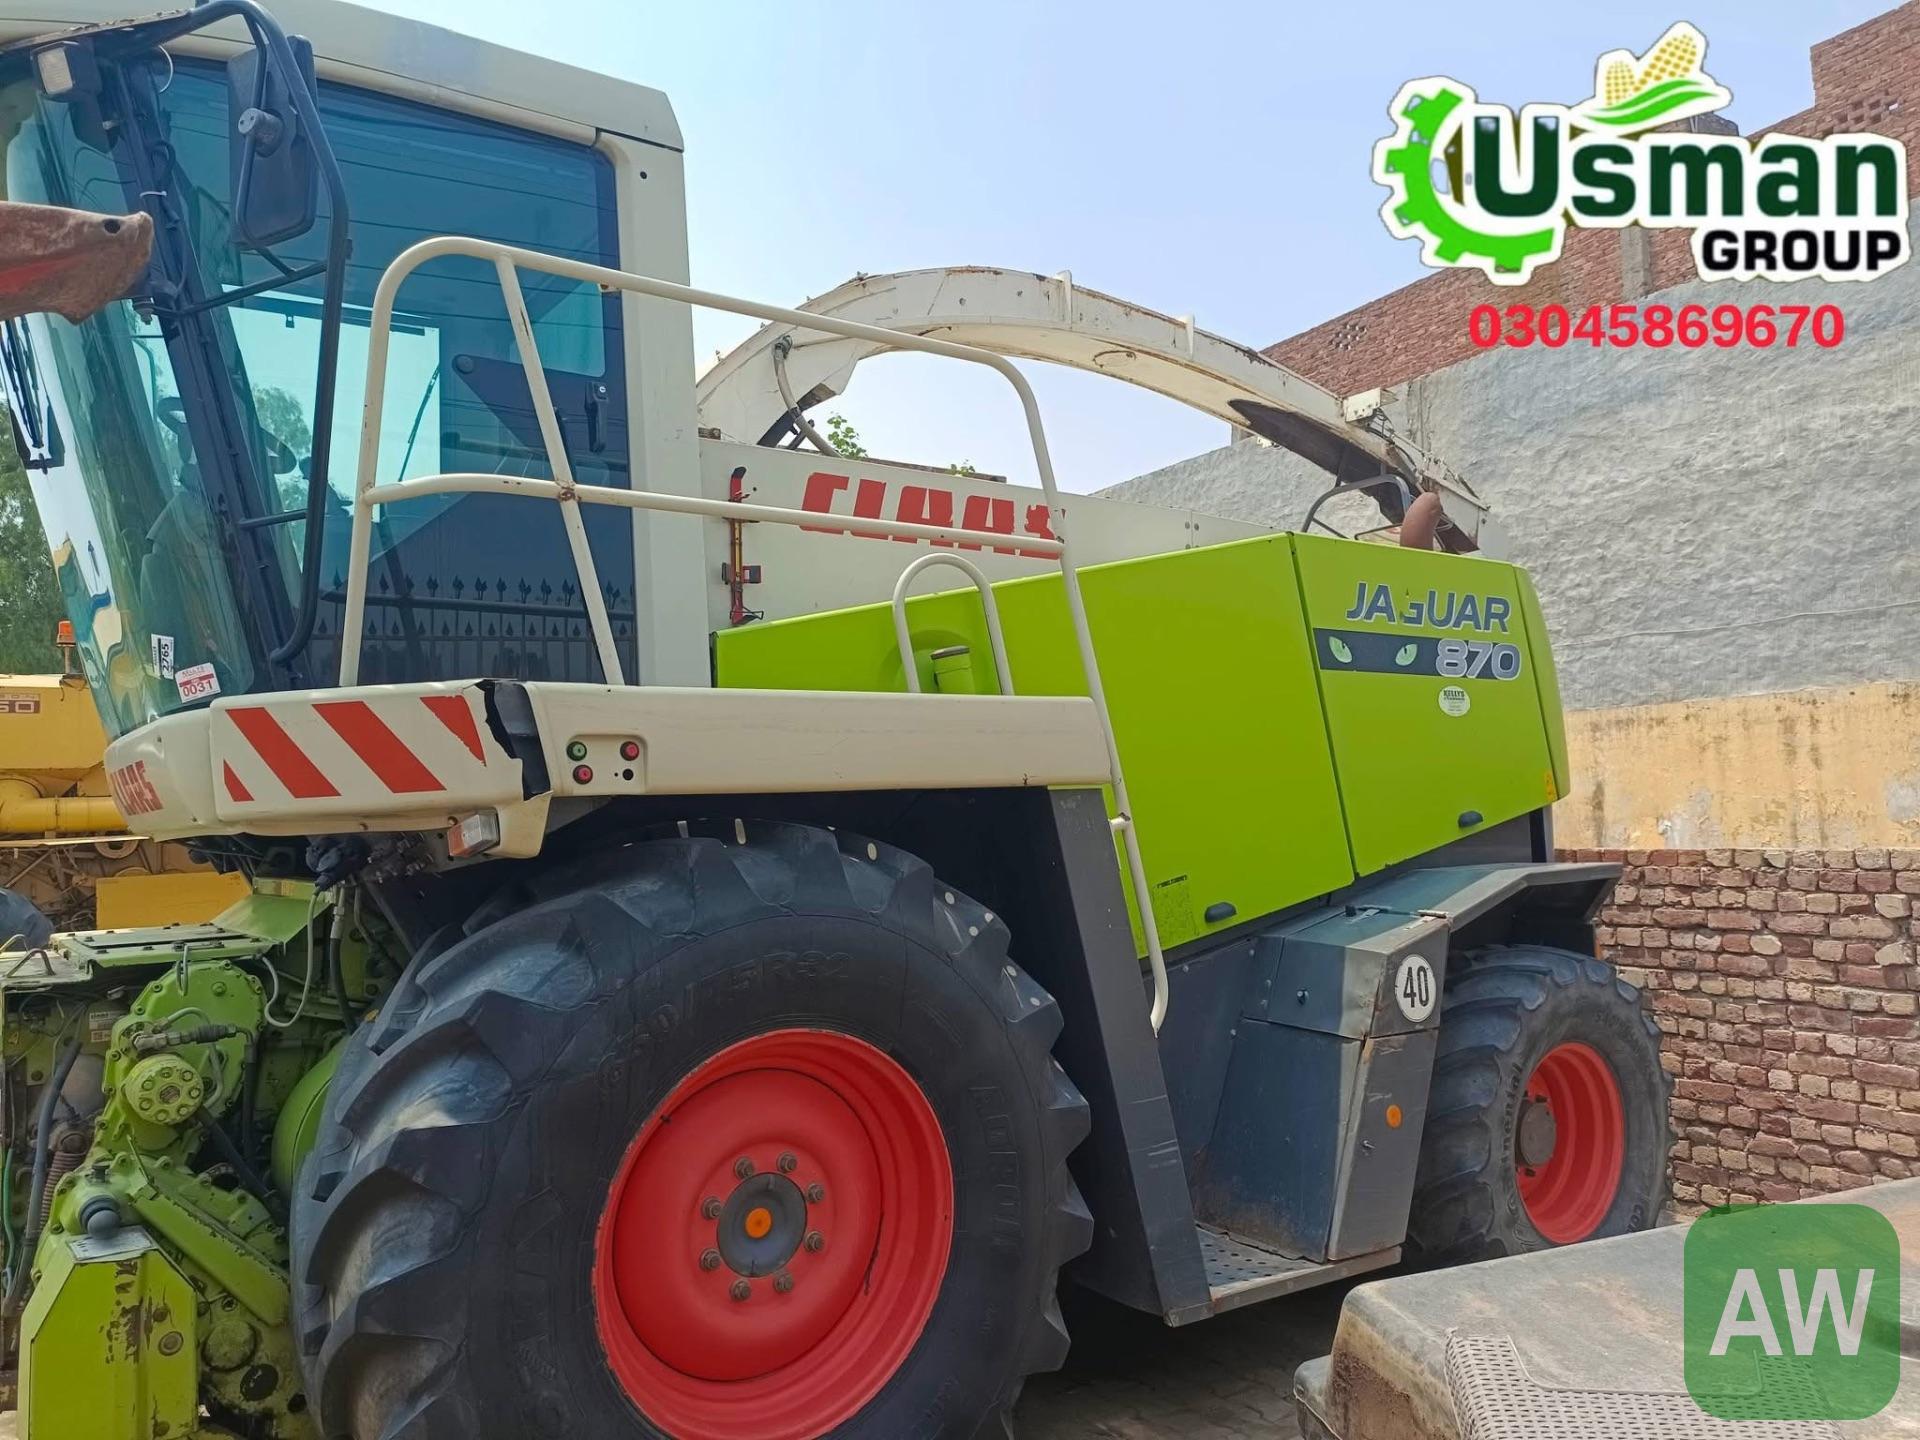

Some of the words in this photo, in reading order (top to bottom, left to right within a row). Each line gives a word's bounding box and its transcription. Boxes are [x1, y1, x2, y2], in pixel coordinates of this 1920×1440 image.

[1346, 581, 1511, 634] JAGUAR
[161, 643, 170, 672] 2765
[1435, 638, 1521, 680] 870
[182, 679, 213, 697] 0031
[1402, 965, 1431, 1009] 40
